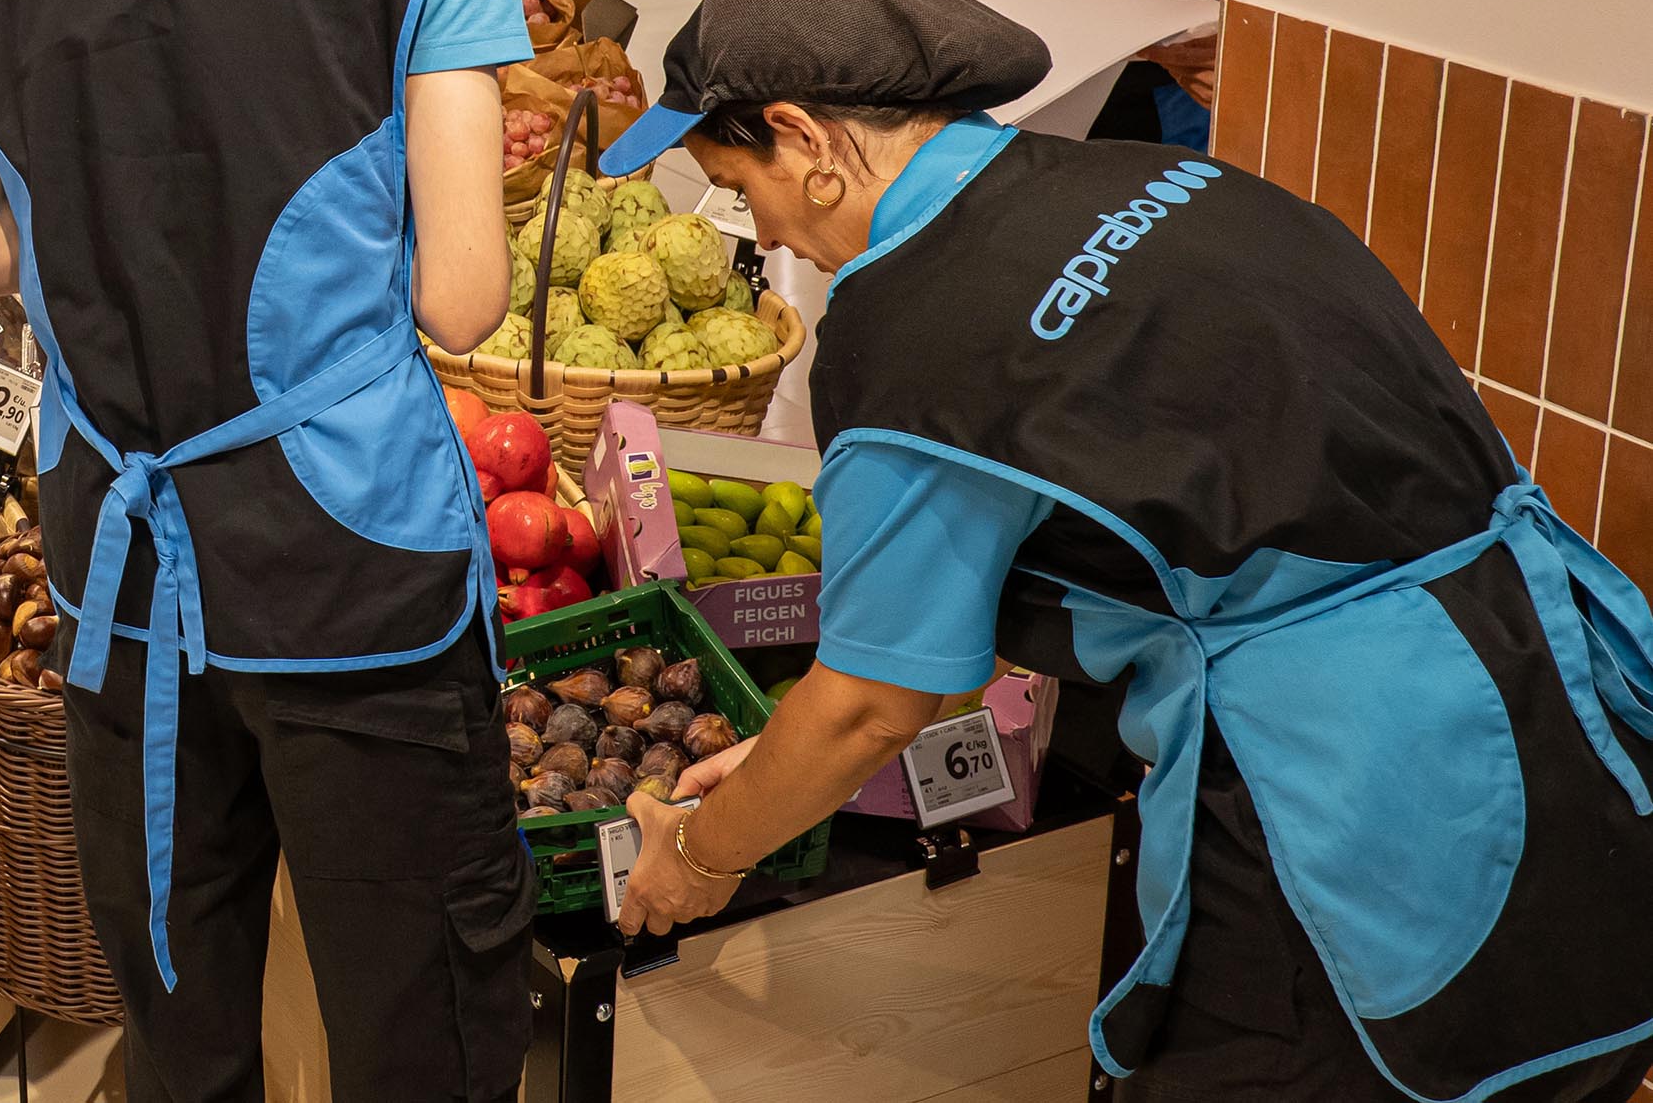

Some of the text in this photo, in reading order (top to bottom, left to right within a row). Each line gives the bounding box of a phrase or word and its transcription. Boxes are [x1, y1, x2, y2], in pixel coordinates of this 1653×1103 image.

[1030, 199, 1168, 341] caprabo
[734, 583, 805, 603] FIGUES
[733, 604, 806, 624] FEIGEN
[745, 626, 796, 644] FICHI
[966, 740, 987, 751] €/kg
[945, 741, 993, 780] 6,70
